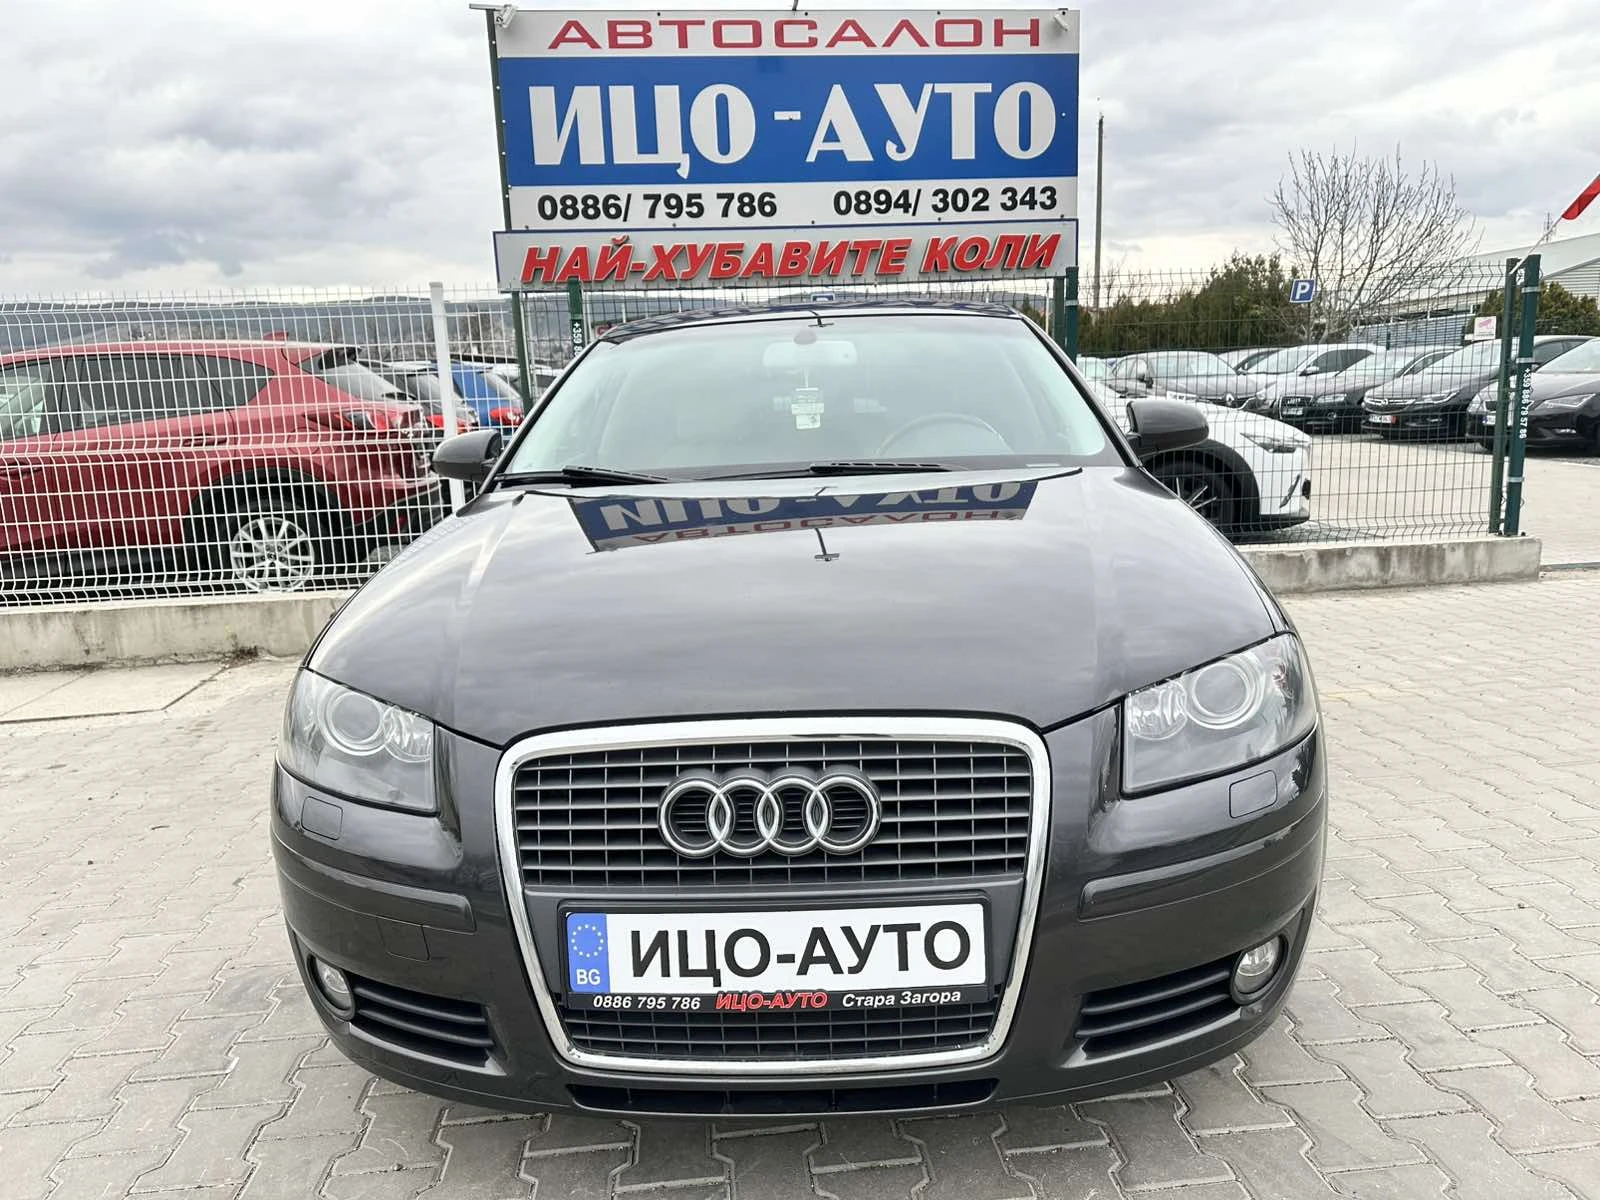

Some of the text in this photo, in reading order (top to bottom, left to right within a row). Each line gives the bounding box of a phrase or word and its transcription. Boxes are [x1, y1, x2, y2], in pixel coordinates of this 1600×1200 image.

[547, 18, 1040, 49] АВТОСАЛОН
[537, 191, 777, 222] 0886/ 795 786
[833, 186, 1057, 216] 0894/ 302 343
[520, 233, 1062, 284] НАЙ-ХУБАВИТЕ КОЛИ
[1295, 281, 1310, 300] P
[631, 920, 971, 988] ИЦО-АУТО
[576, 969, 600, 985] BG
[593, 990, 961, 1012] 0886 795 786 ИЦО-АУТО Стара Загора
